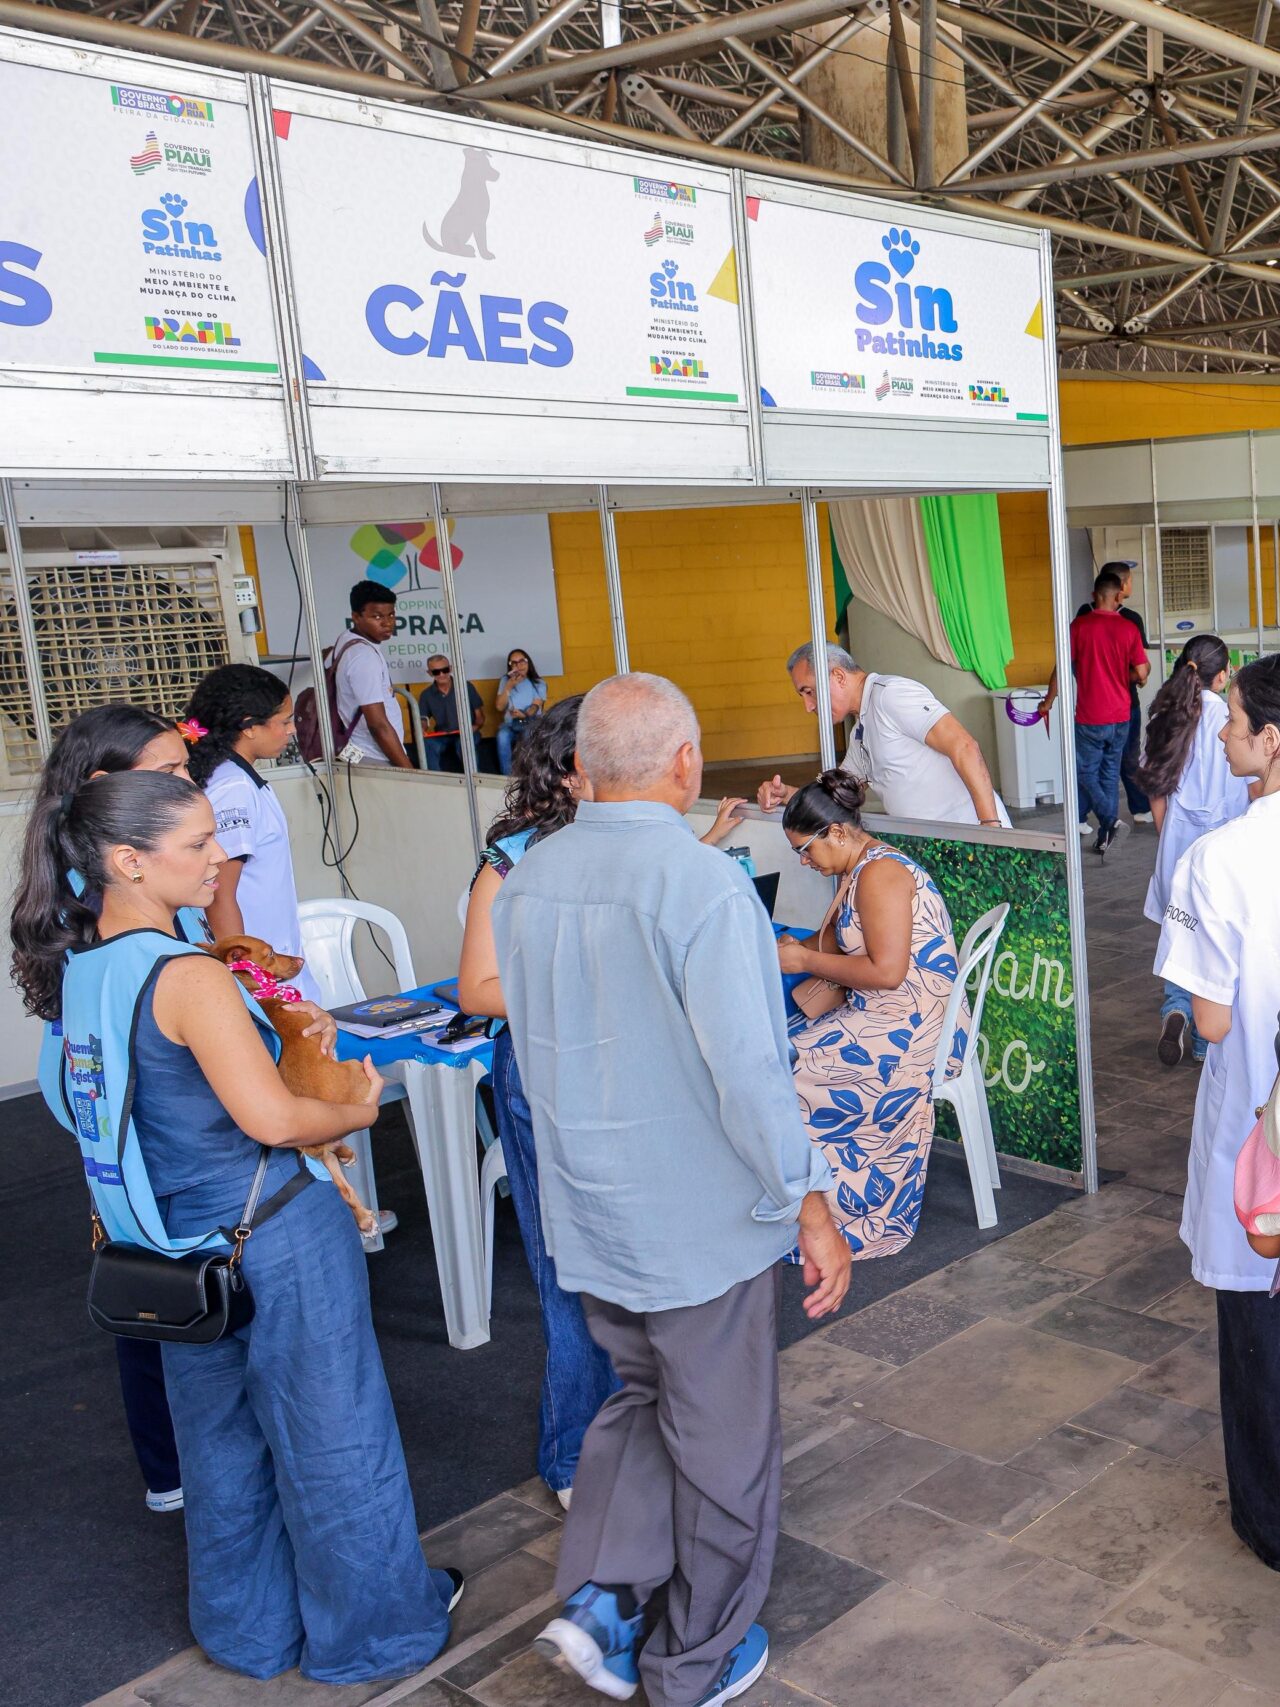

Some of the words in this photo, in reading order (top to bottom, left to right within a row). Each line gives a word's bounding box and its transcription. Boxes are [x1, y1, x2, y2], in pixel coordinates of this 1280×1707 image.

[120, 90, 167, 104] GOVERNO
[121, 98, 136, 106] DO
[138, 100, 168, 112] BRASIL
[114, 106, 141, 116] FEIRA
[146, 112, 158, 120] DA
[163, 114, 215, 128] CIDADANIA
[187, 109, 205, 119] RUA
[164, 143, 198, 153] GOVERNO
[141, 208, 218, 247] Sin
[142, 242, 222, 262] Patinhas
[150, 268, 205, 280] MINISTÉRIO
[144, 278, 168, 286] MEIO
[172, 280, 220, 290] AMBIENTE
[650, 272, 696, 302] Sin
[140, 287, 187, 298] MUDANÇA
[208, 294, 236, 302] CLIMA
[854, 261, 958, 334] Sin
[164, 309, 202, 318] GOVERNO
[650, 298, 699, 312] Patinhas
[365, 270, 574, 368] CÃES
[144, 316, 242, 346] BRASIL
[668, 327, 697, 336] AMBIENTE
[854, 328, 963, 362] Patinhas
[650, 356, 709, 378] BRASIL
[392, 613, 485, 636] PRAA
[388, 643, 438, 656] PEDRO
[1166, 904, 1198, 932] FIOCRUZ
